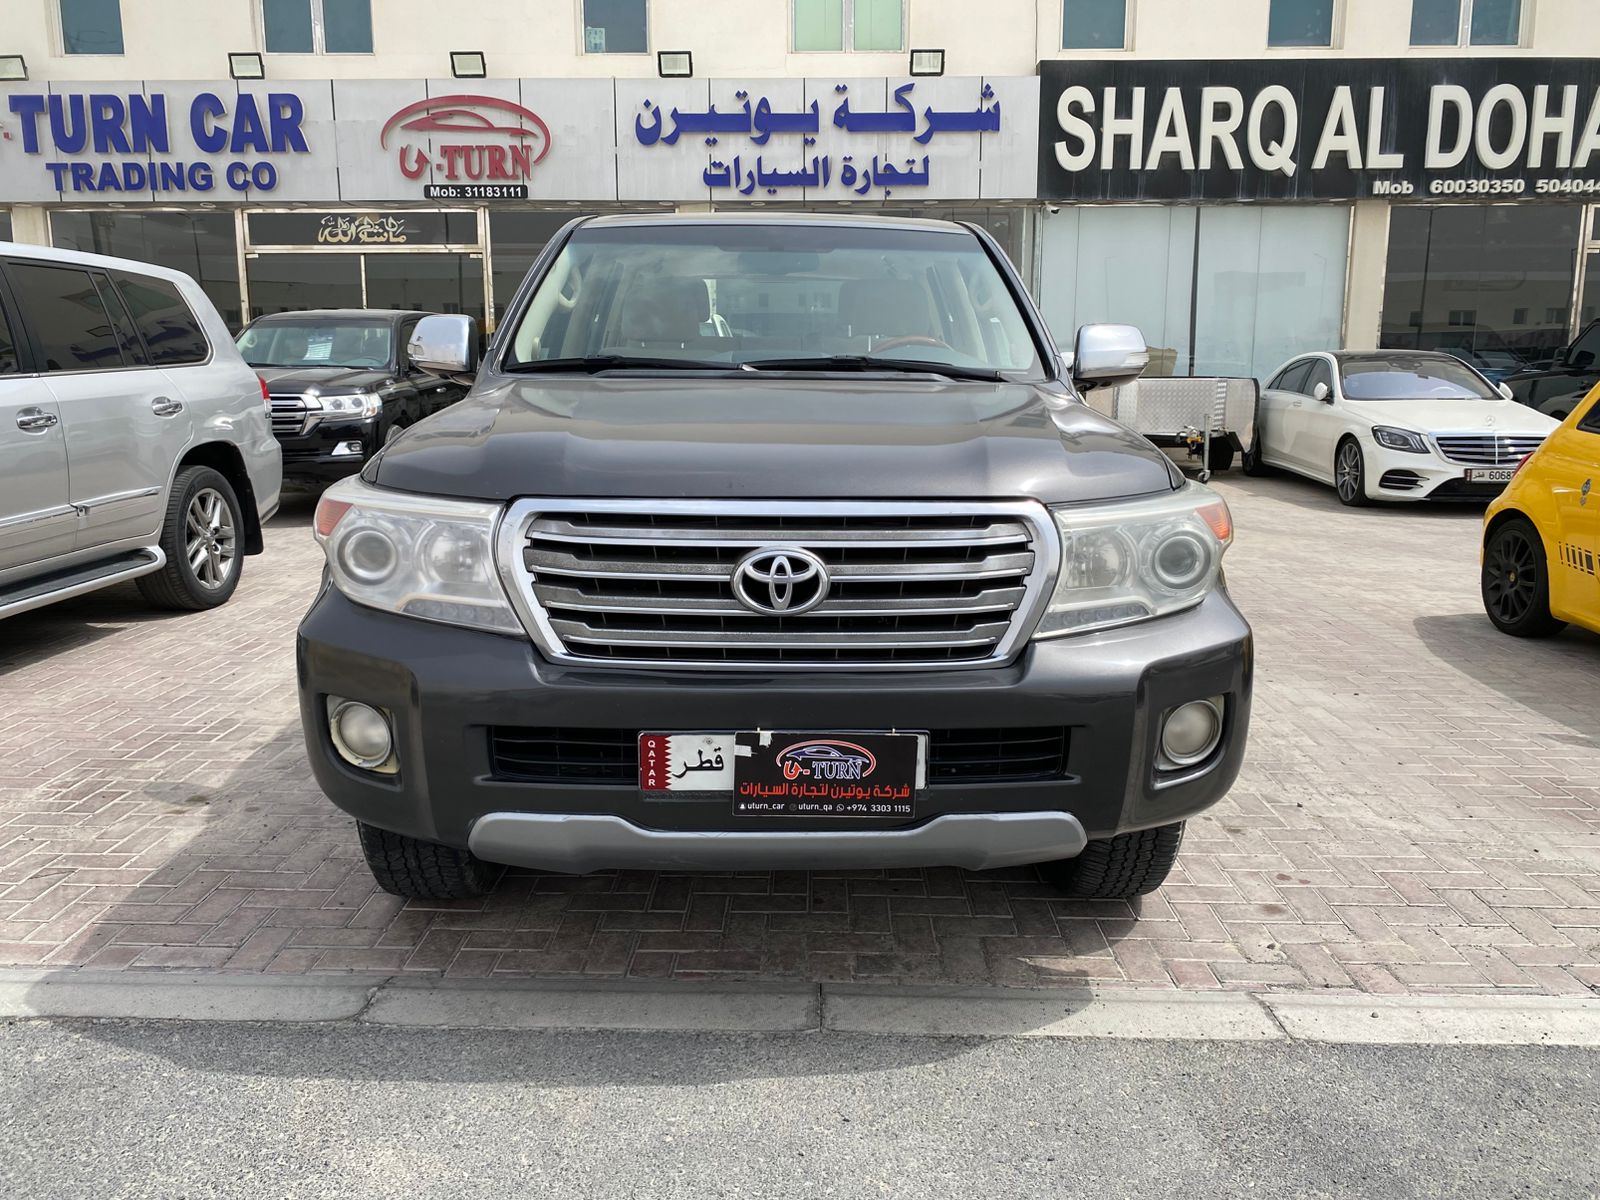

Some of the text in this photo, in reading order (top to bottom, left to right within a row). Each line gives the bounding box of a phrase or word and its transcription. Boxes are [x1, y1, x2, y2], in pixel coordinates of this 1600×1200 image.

[8, 92, 311, 154] TURN CAR
[635, 82, 1001, 147] شركة يوتيرن
[1054, 85, 1298, 177] SHARQ
[1311, 85, 1404, 170] AL
[45, 161, 278, 192] TRADING CO
[702, 154, 930, 197] لتجارة السيارات
[1372, 180, 1414, 195] Mob
[1429, 178, 1525, 194] 60030350
[429, 186, 522, 198] Mob: 31183111
[647, 740, 656, 786] QATAR
[672, 746, 724, 778] قطر
[740, 782, 911, 800] شركة يوتيرن لتجارة السيارات
[747, 801, 911, 813] uturn_car uturn_qa +974 3303 1115
